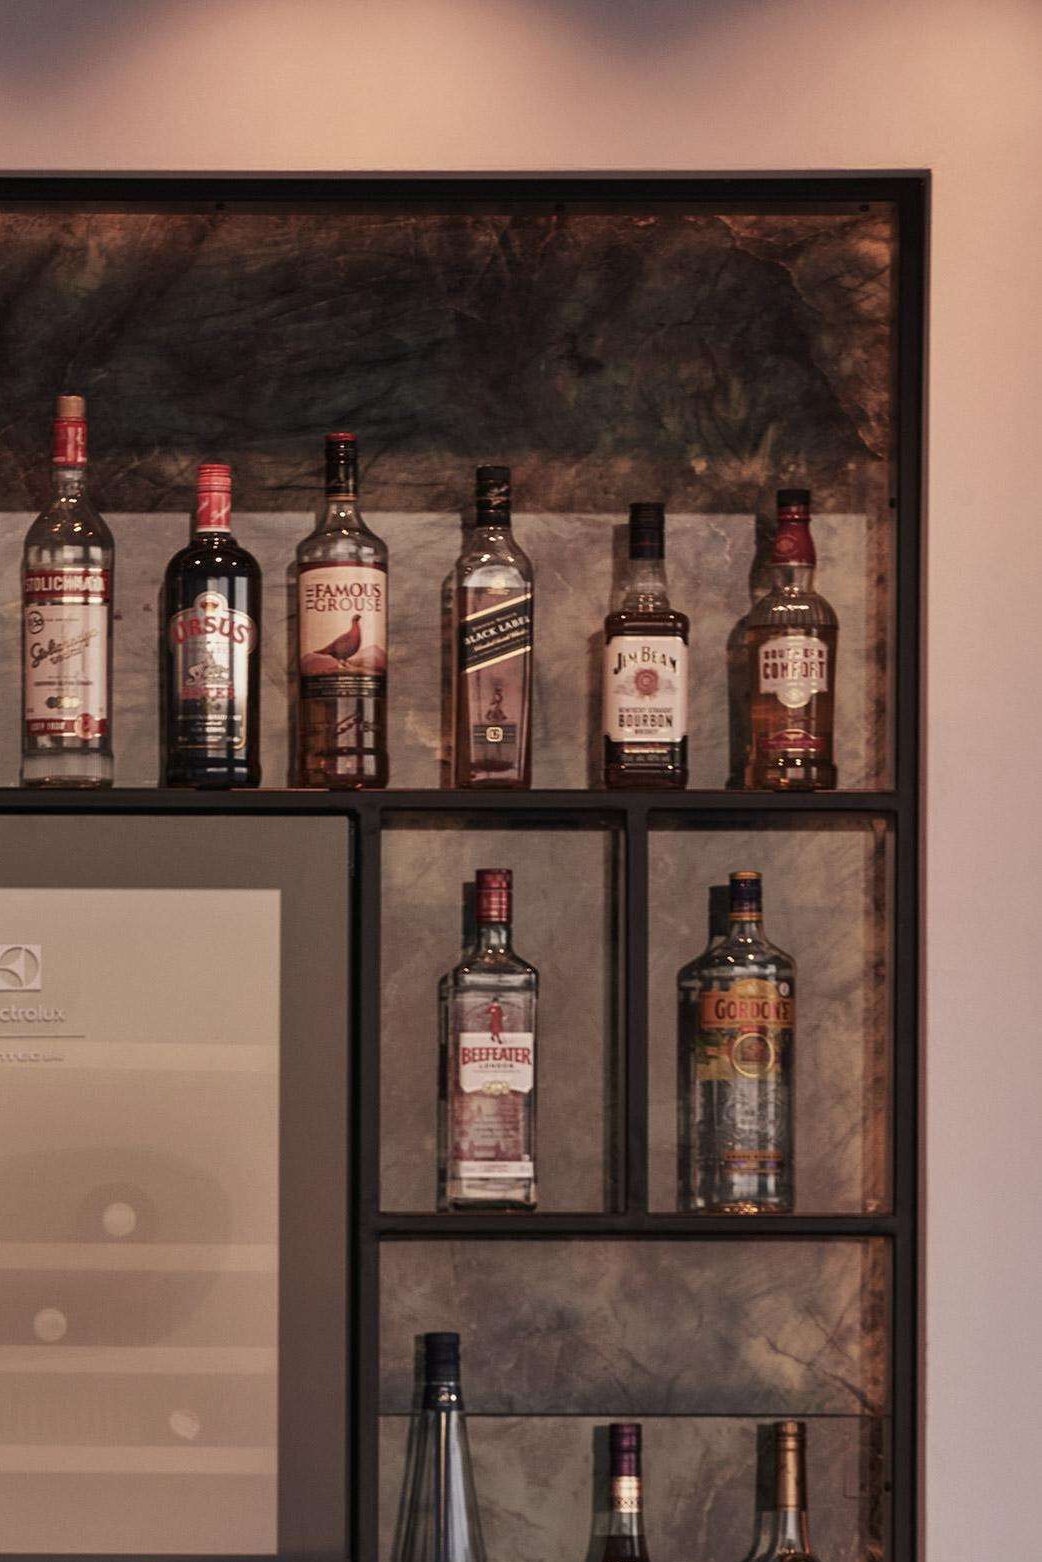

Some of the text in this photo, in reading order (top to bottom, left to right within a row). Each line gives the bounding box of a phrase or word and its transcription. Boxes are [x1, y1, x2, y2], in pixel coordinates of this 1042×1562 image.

[315, 583, 382, 598] FAMOUS
[314, 598, 382, 612] GROUSE
[173, 617, 254, 644] URSUS
[614, 646, 677, 675] JIM BEAM
[762, 661, 825, 679] COMFORT
[618, 714, 674, 728] BOURBON
[462, 1047, 532, 1065] BEEFEATER
